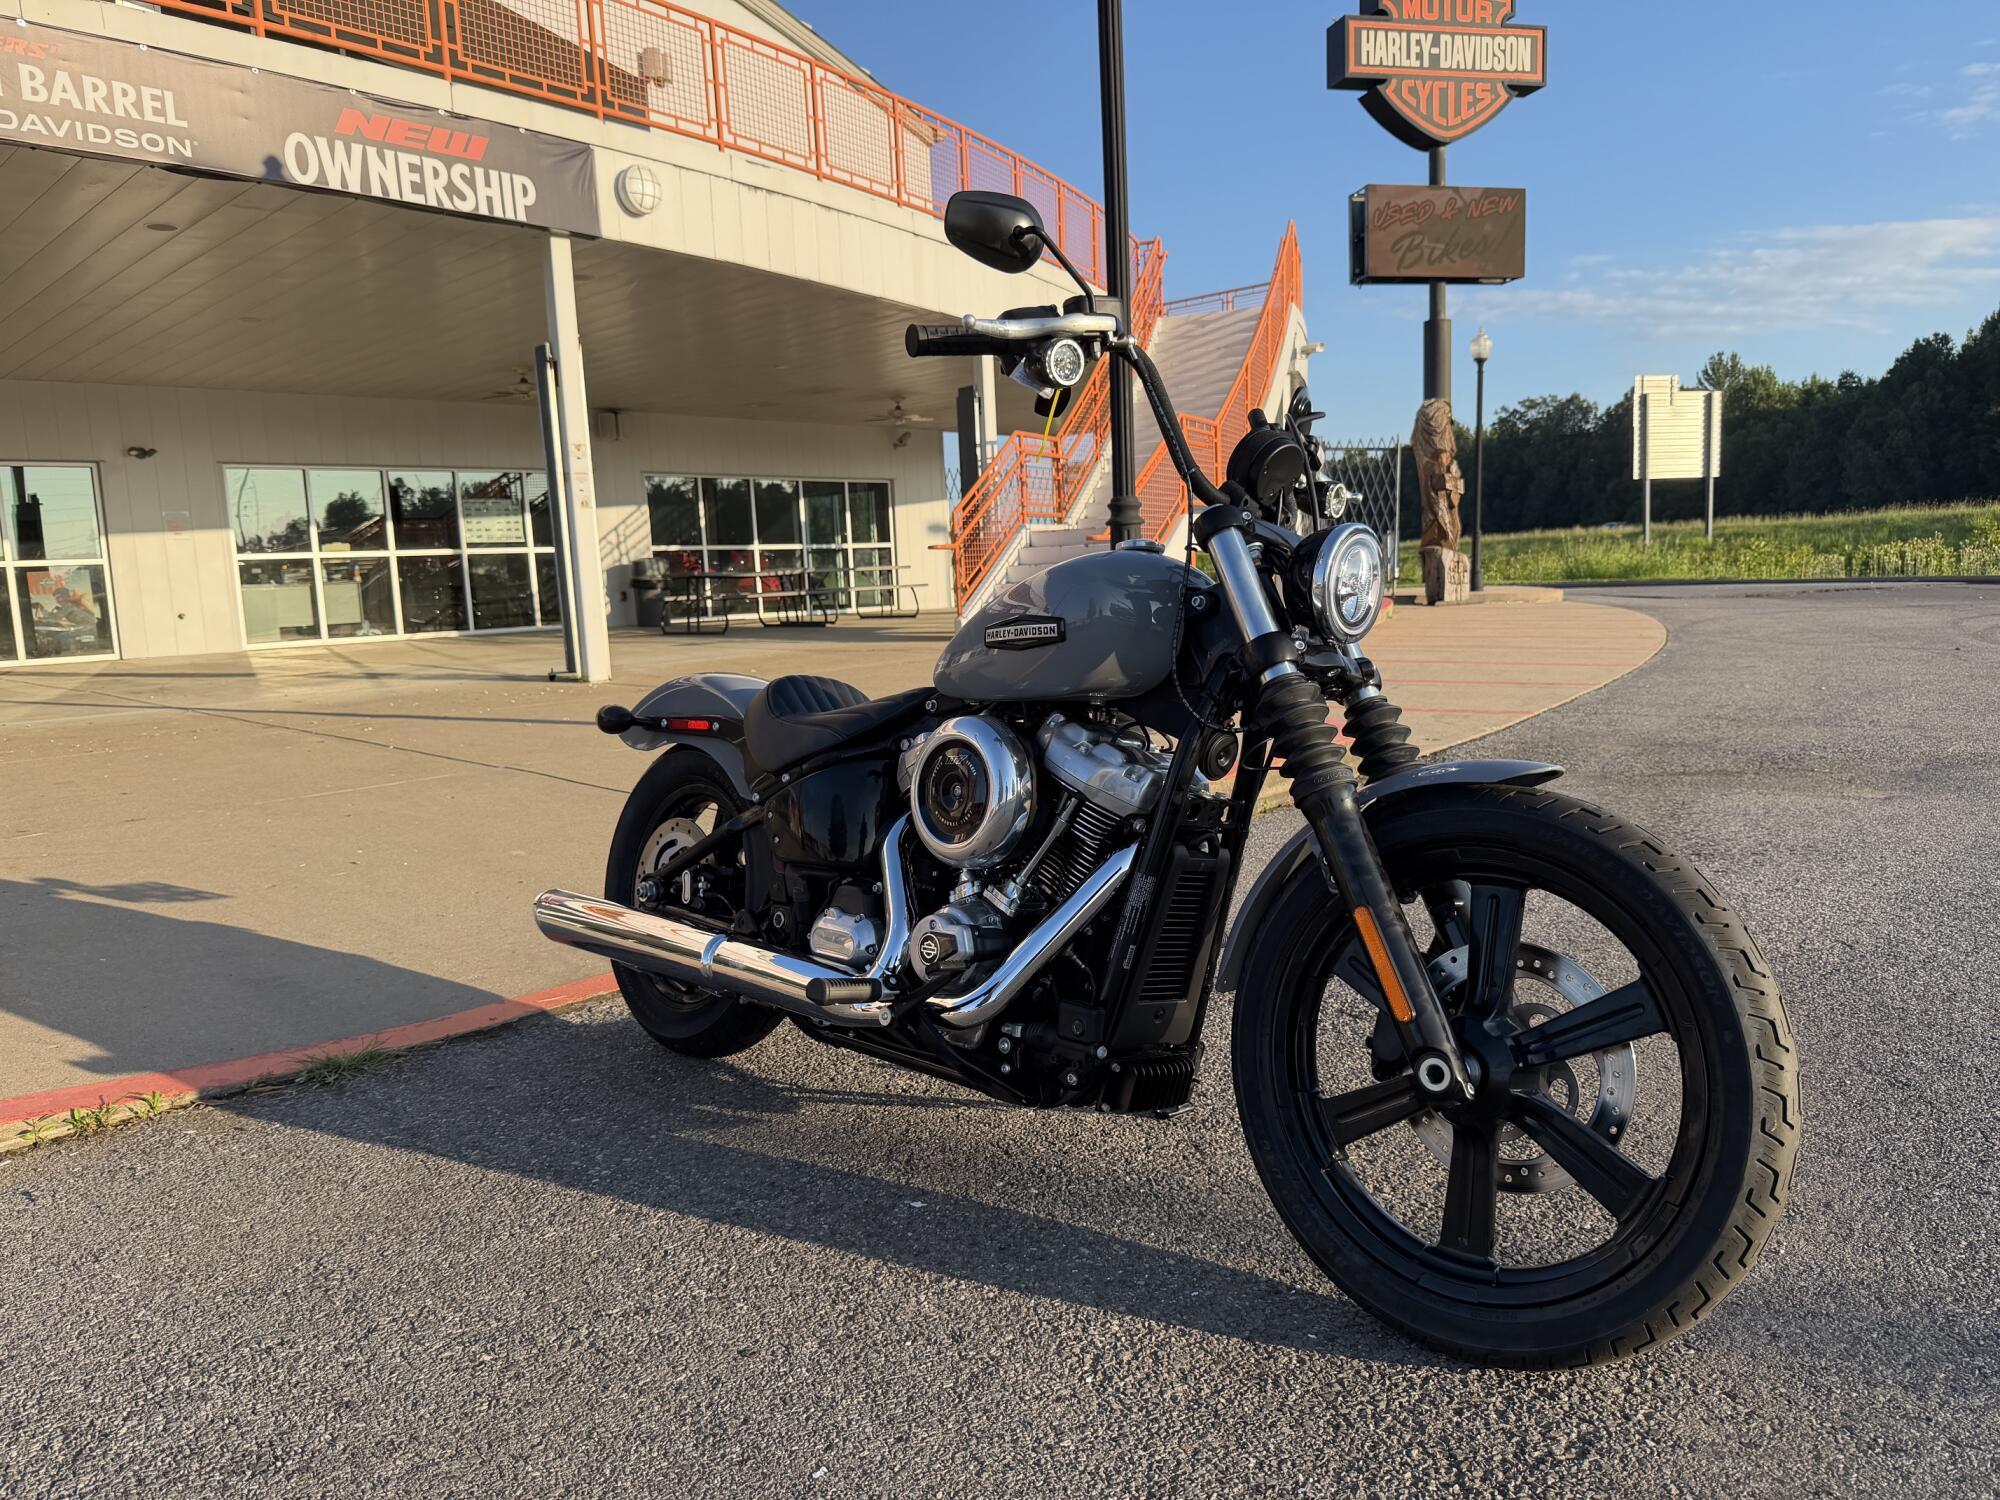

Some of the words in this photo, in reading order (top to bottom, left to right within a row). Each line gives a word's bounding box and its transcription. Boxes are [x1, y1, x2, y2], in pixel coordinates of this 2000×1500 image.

[1402, 0, 1492, 24] MOTOR
[1360, 29, 1532, 72] HARLEY-DAVIDSON
[18, 62, 188, 128] BARREL
[1401, 79, 1493, 126] CYCLES
[334, 107, 489, 161] NEW
[283, 132, 537, 221] OWNERSHIP
[1373, 200, 1435, 230] USED
[1441, 198, 1458, 219] &
[1467, 194, 1520, 217] NEW
[986, 625, 1057, 641] HARLEY-DAVIDSON
